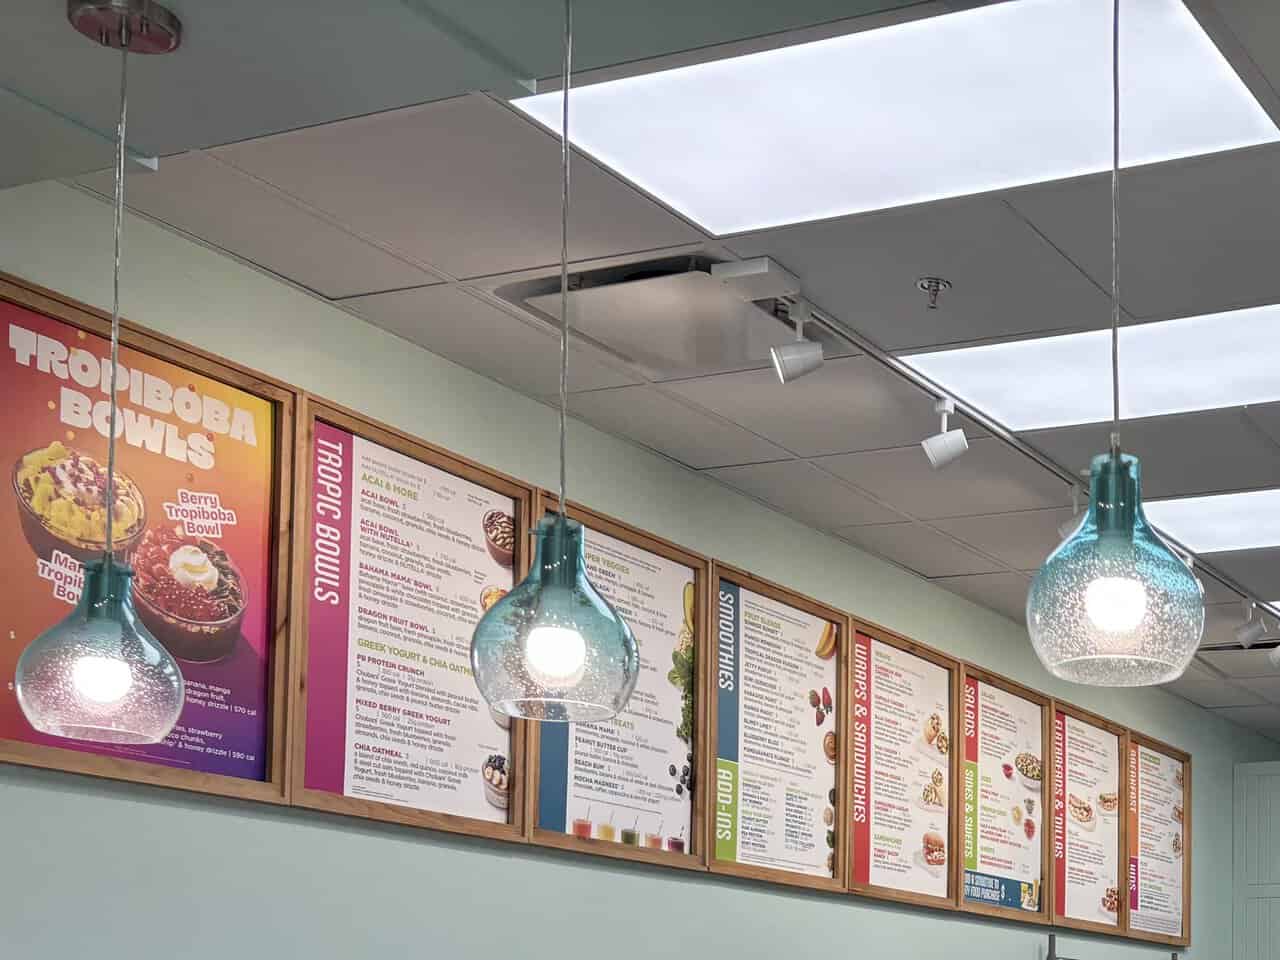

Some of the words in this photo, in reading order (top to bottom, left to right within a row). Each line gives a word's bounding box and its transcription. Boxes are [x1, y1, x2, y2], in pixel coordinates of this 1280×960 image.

[9, 323, 257, 447] TROPIBOBA
[60, 386, 215, 470] BOWLS
[316, 439, 342, 520] TROPIC
[361, 472, 384, 488] ACAI
[180, 492, 217, 509] Berry
[361, 488, 378, 500] ACAI
[379, 495, 399, 508] BOWL
[166, 505, 234, 522] Tropiboba
[360, 517, 378, 529] ACAI
[378, 523, 399, 536] BOWL
[187, 522, 219, 535] Bowl
[360, 524, 380, 537] WITH
[314, 524, 341, 605] BOWLS
[359, 561, 390, 577] BAHAMA
[413, 579, 433, 591] BOWL
[358, 605, 388, 620] DRAGON
[389, 615, 408, 626] FRUIT
[410, 621, 429, 633] BOWL
[719, 591, 734, 691] SMOOTHIES
[357, 637, 386, 653] GREEK
[387, 646, 421, 662] YOGURT
[429, 657, 448, 670] CHIA
[449, 663, 475, 677] OATM
[367, 655, 396, 669] PROTEIN
[397, 664, 425, 677] CRUNCH
[855, 644, 867, 700] WRAPS
[355, 697, 378, 708] MIXED
[379, 703, 401, 714] BERRY
[402, 708, 425, 720] GREEK
[425, 714, 451, 726] YOGURT
[854, 704, 867, 718] &
[965, 685, 976, 737] SALADS
[354, 742, 371, 752] CHIA
[372, 746, 402, 758] OATMEAL
[575, 735, 595, 746] PEANUT
[596, 740, 615, 751] BUTTER
[574, 758, 592, 767] BEACH
[854, 721, 867, 823] SANDWICHES
[574, 774, 592, 784] MOCHA
[965, 769, 974, 800] SIDES
[717, 769, 733, 840] ADD-INS
